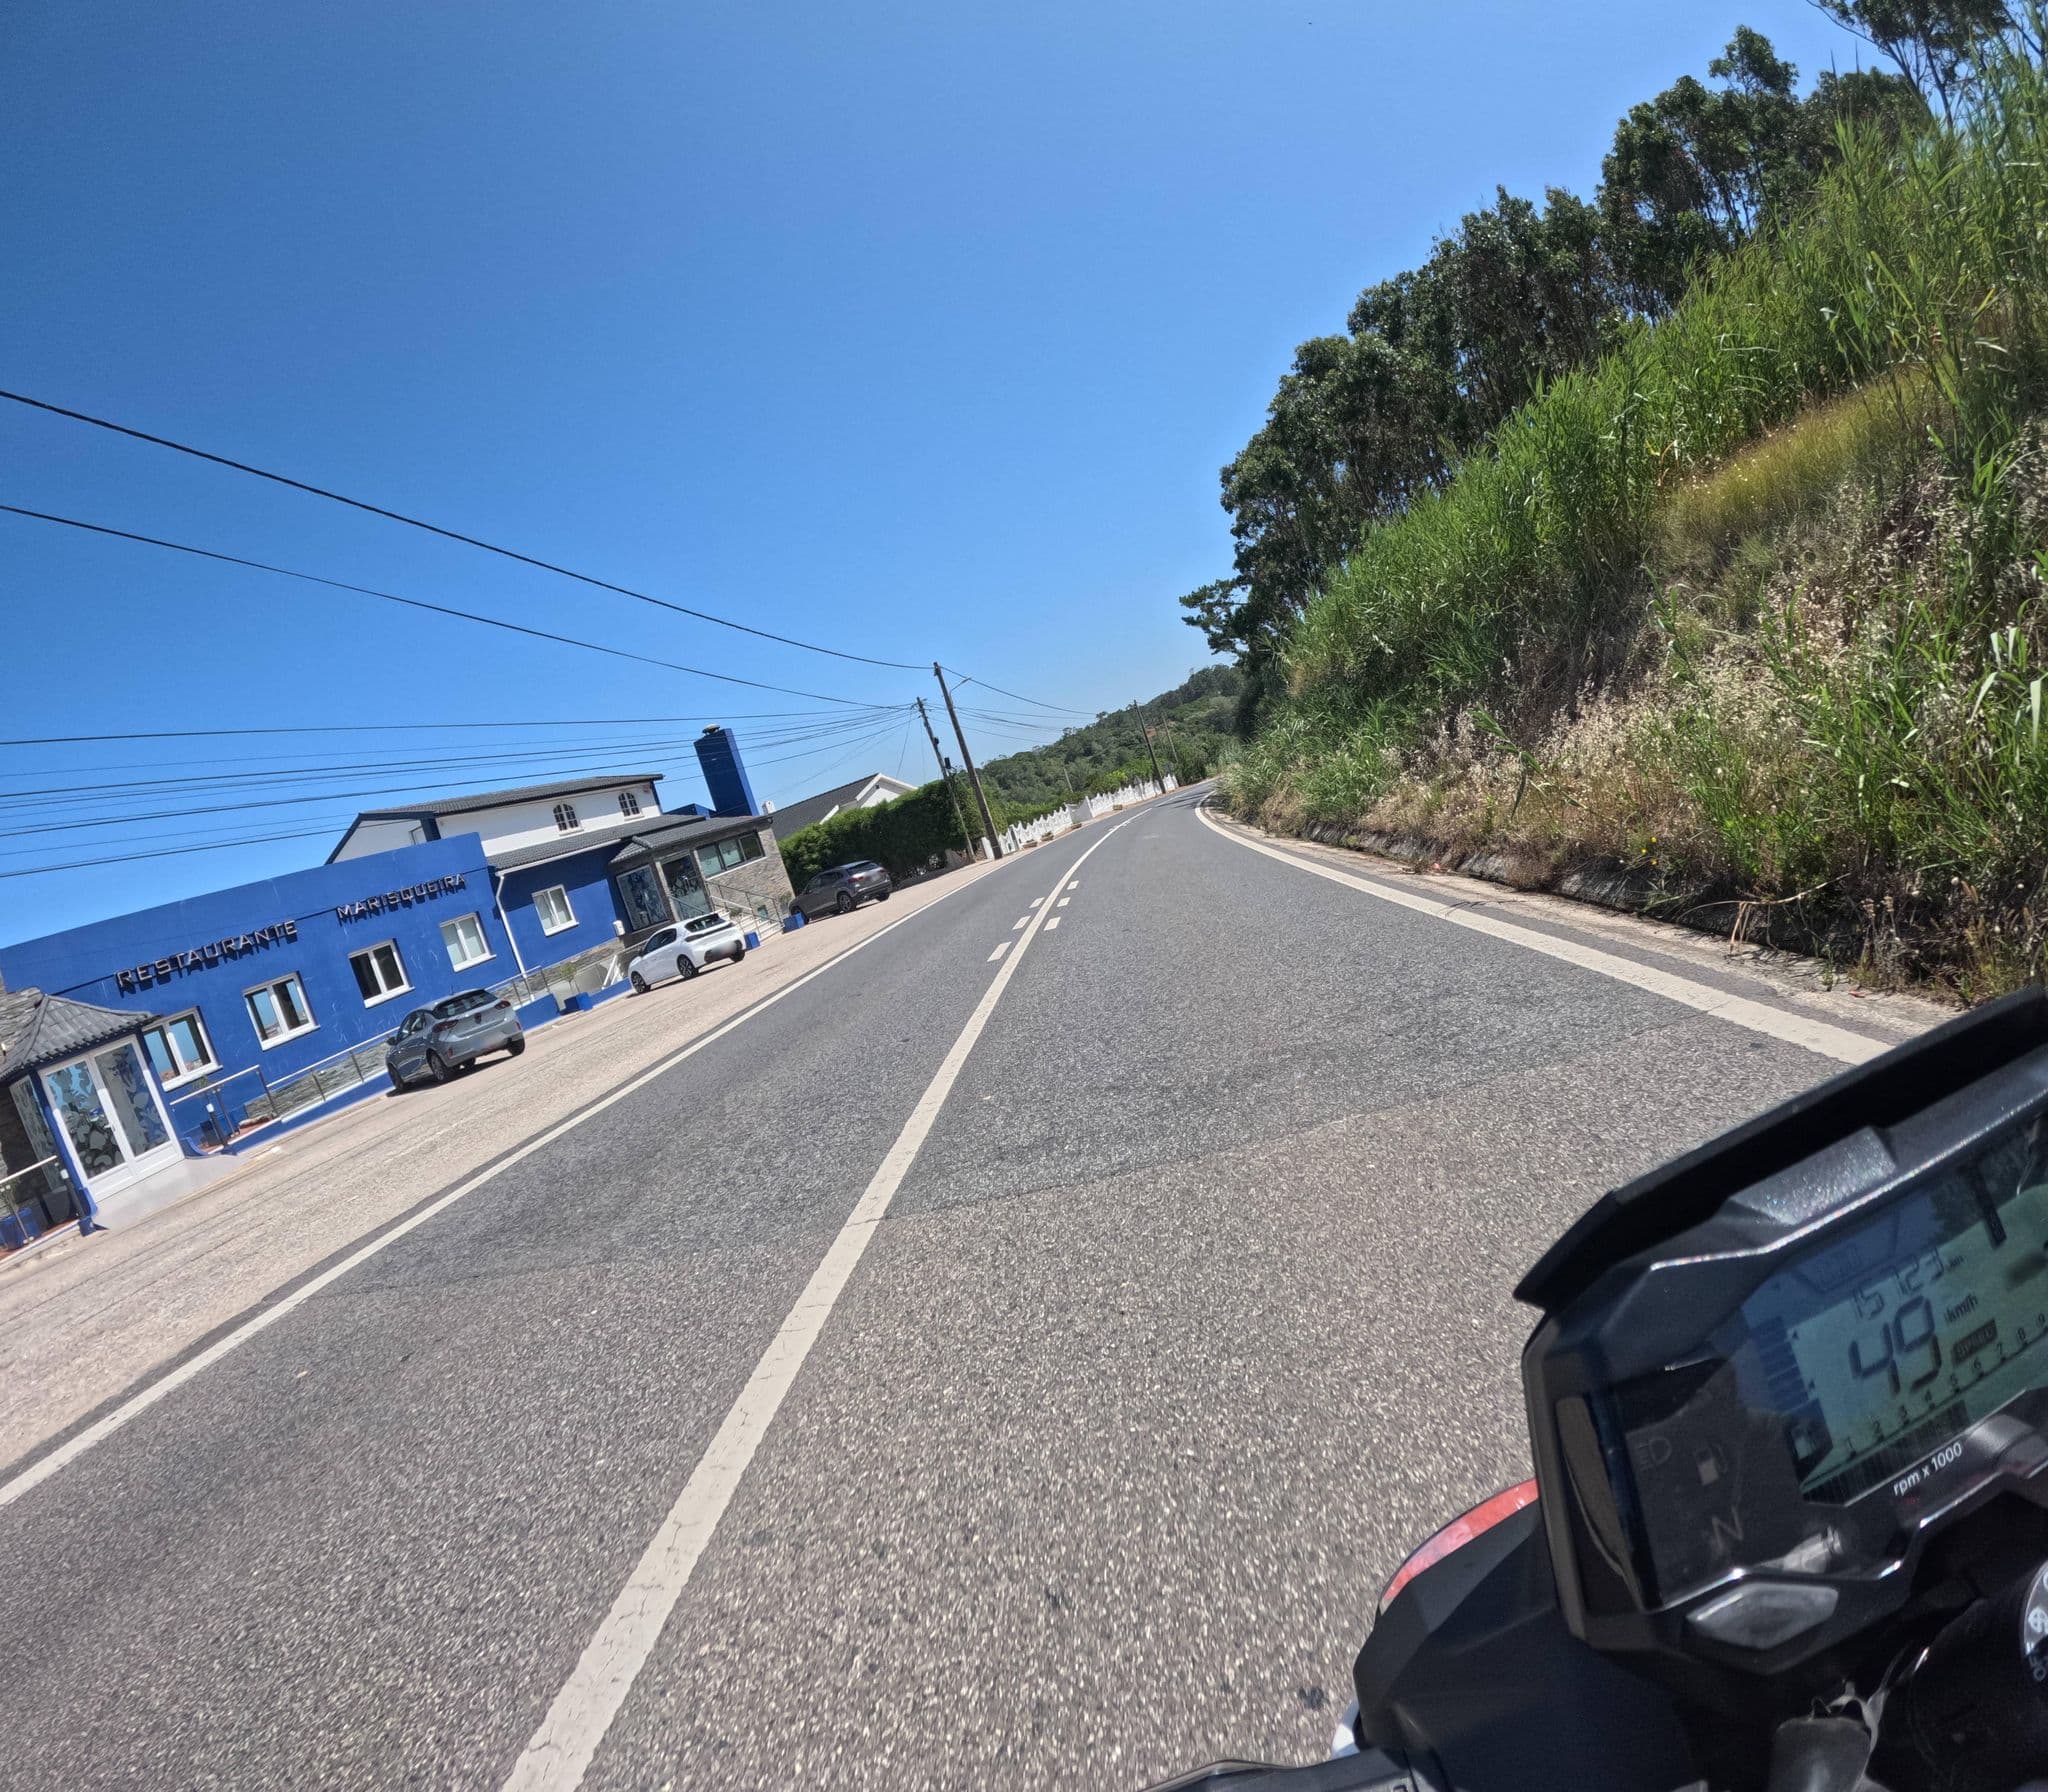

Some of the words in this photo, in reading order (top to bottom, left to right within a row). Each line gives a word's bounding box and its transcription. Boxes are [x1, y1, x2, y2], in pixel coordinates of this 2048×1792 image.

[116, 920, 298, 989] RESTAURANTE
[336, 874, 466, 920] MARISQUEIRA
[1848, 1296, 1942, 1394] 49
[1944, 1293, 1978, 1321] km/h
[1893, 1471, 1920, 1496] rpm
[1921, 1465, 1930, 1479] x
[1931, 1441, 1962, 1471] 1000
